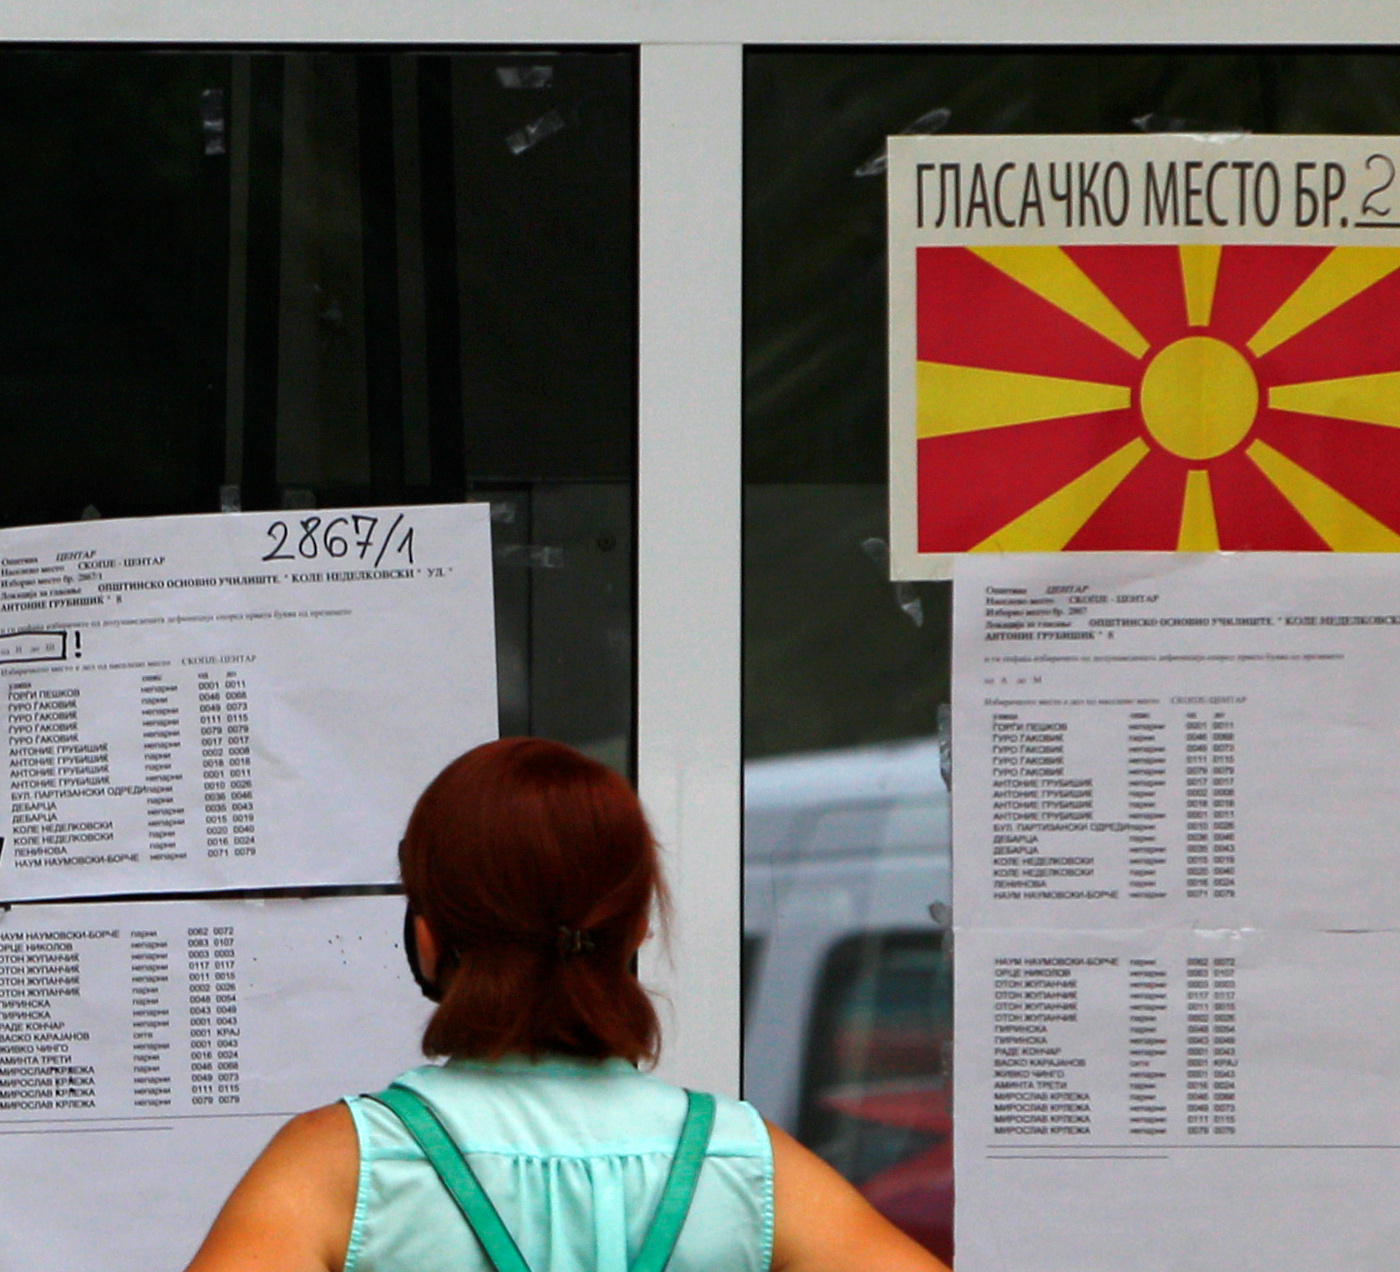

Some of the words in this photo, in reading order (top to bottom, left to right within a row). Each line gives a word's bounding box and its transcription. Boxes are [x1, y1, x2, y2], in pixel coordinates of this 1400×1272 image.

[917, 161, 1129, 228] ГЛАСАЧКО
[1144, 161, 1280, 227] МЕСТО
[1296, 162, 1348, 228] БР.
[262, 513, 413, 568] 2867/1
[56, 550, 96, 562] ЦЕНТАР
[124, 556, 165, 567] ЦЕНТАР
[98, 580, 164, 592] ОПШТИНСКО
[167, 578, 217, 589] ОСНОВНО
[292, 572, 323, 583] КОЛЕ
[326, 567, 414, 583] НЕДЕЛКОВСКИ
[1, 600, 46, 612] АНТОНИЕ
[33, 1032, 89, 1042] КАРАЈАНОВ
[216, 1028, 240, 1037] КРАЈ
